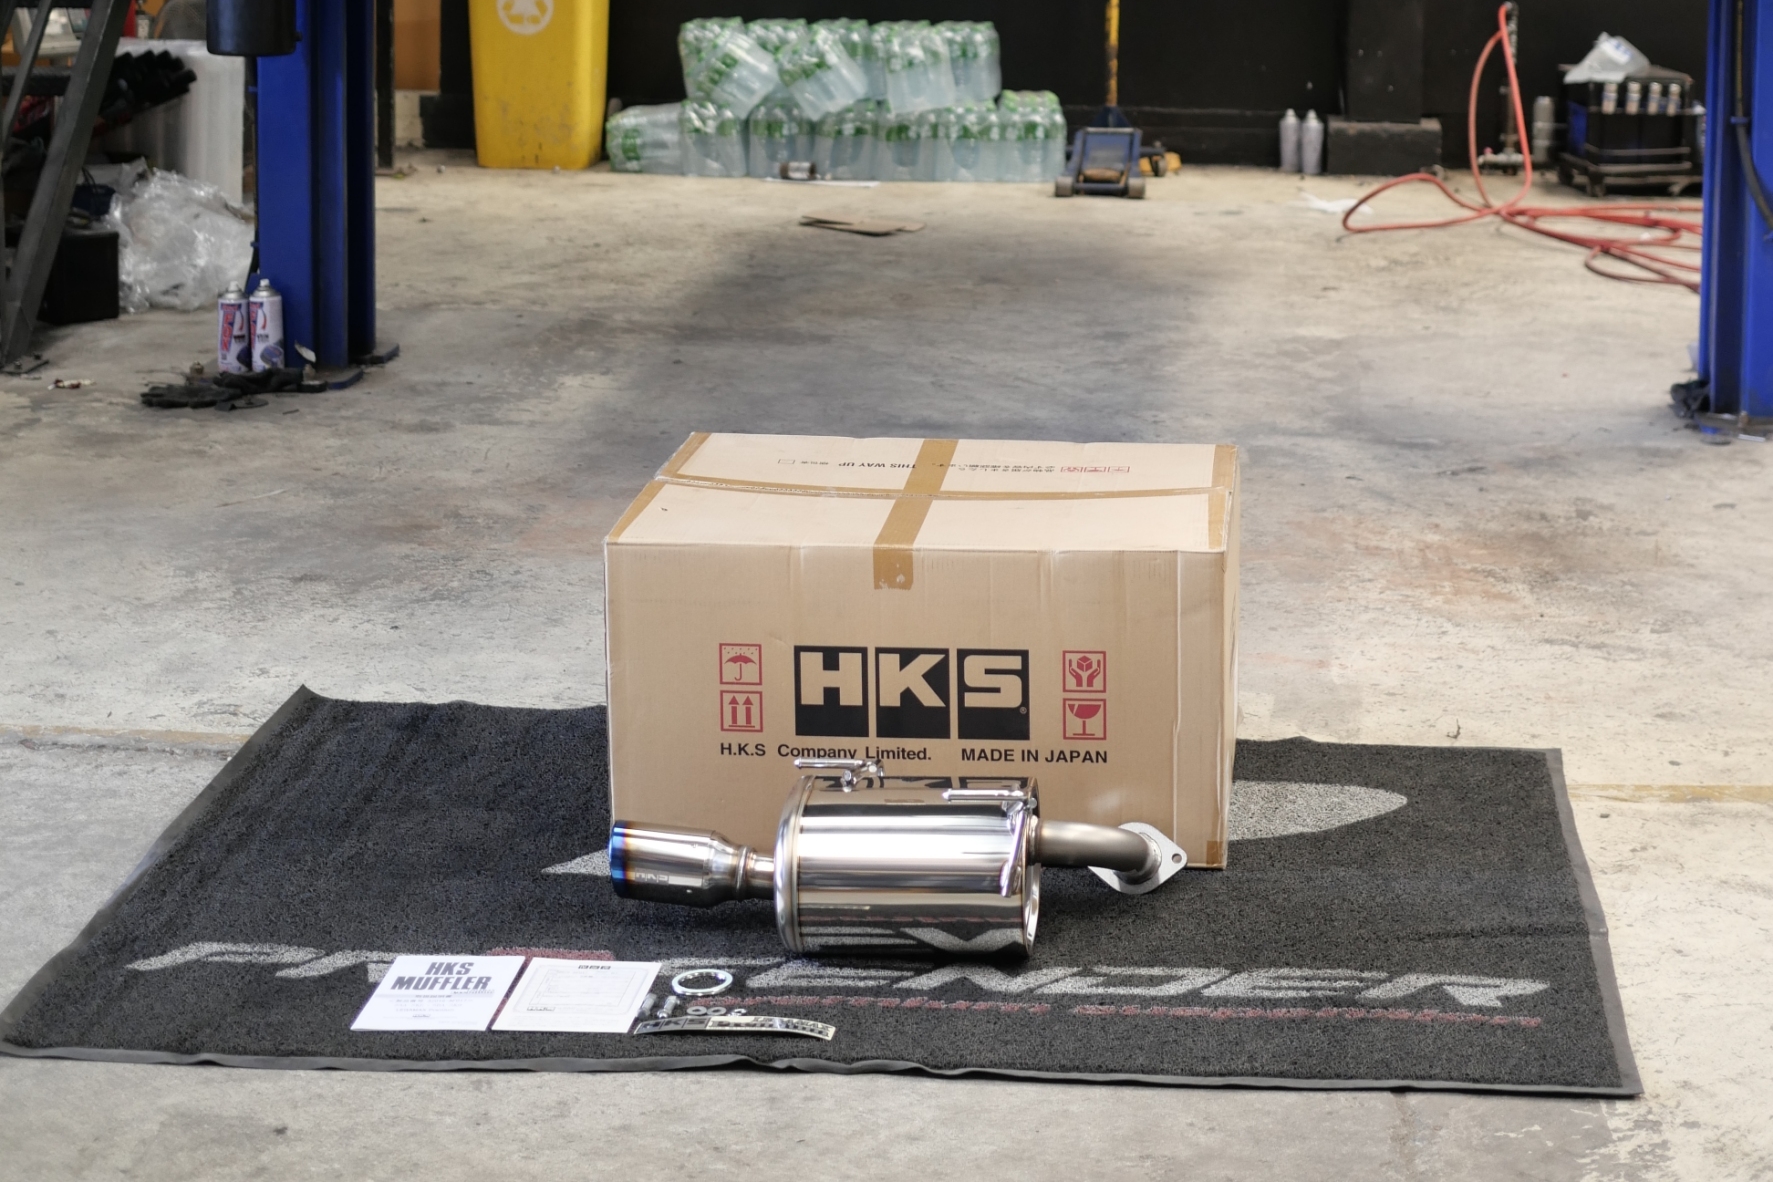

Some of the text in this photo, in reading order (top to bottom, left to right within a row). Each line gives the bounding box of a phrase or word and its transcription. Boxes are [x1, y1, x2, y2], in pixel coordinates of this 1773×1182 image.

[799, 650, 1023, 709] HKS
[720, 742, 1108, 764] H.K.S Company Limited. MADE IN JAPAN
[424, 961, 475, 976] HKS
[390, 975, 493, 991] MUFFLER
